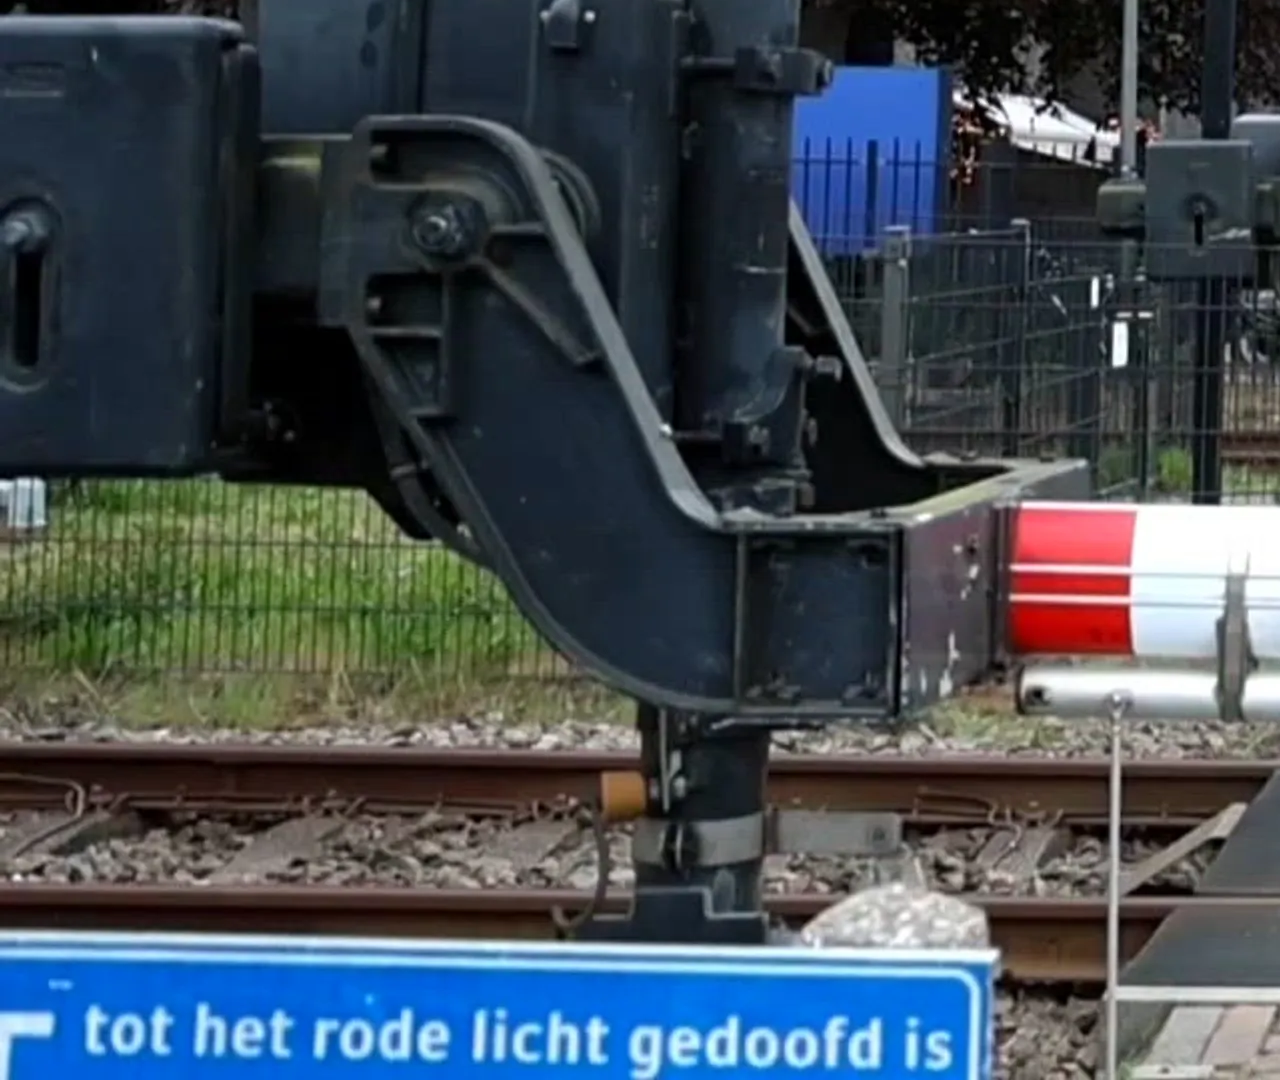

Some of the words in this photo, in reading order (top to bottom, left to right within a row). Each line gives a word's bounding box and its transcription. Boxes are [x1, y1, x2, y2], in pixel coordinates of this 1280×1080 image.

[84, 1003, 175, 1056] tot
[194, 1002, 294, 1058] het
[313, 1008, 450, 1062] rode
[471, 1010, 609, 1065] licht
[629, 1016, 883, 1080] gedoofd
[904, 1017, 954, 1070] is
